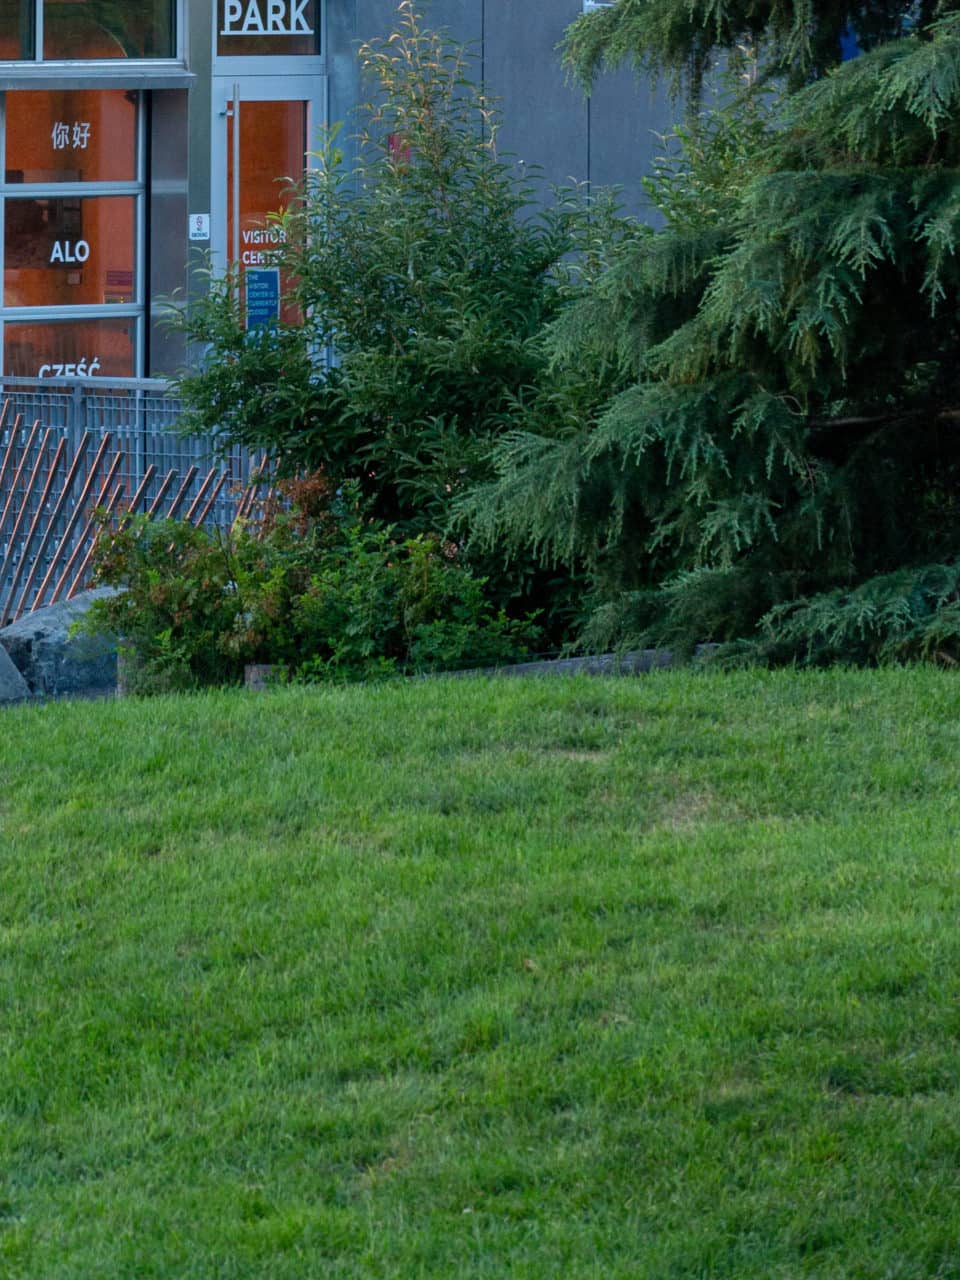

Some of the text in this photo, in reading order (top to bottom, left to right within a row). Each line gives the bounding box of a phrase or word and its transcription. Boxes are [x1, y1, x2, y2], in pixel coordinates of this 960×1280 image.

[51, 121, 91, 150] 你好
[242, 229, 287, 244] VISITOR
[50, 239, 90, 263] ALO
